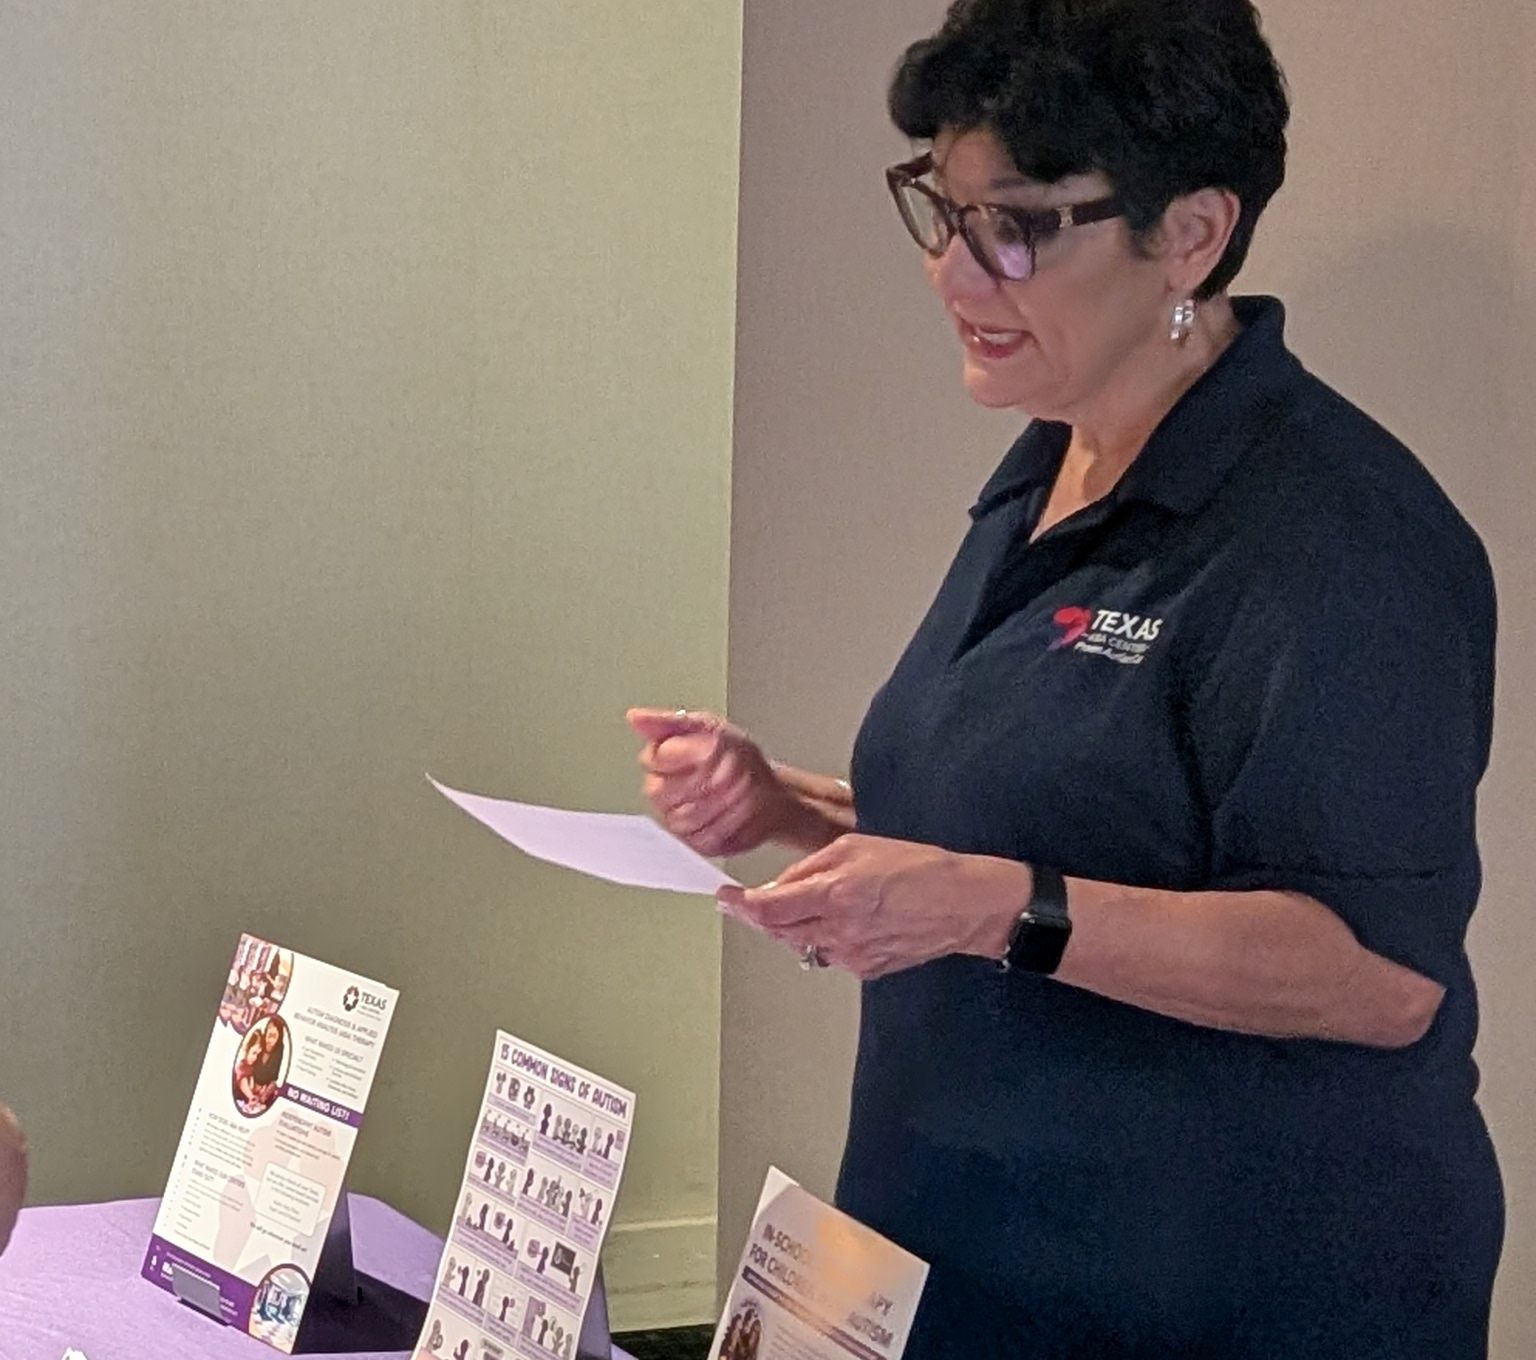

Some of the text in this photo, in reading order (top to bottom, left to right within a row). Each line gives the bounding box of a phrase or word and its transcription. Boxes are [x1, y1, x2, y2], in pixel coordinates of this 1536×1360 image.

[1091, 608, 1164, 641] TEXAS
[361, 991, 388, 1010] TEXAS
[511, 1048, 549, 1081] COMMON
[550, 1066, 577, 1094] SIGNS
[578, 1080, 592, 1100] OF
[591, 1087, 628, 1119] AUTISM
[748, 1242, 769, 1269] FOR
